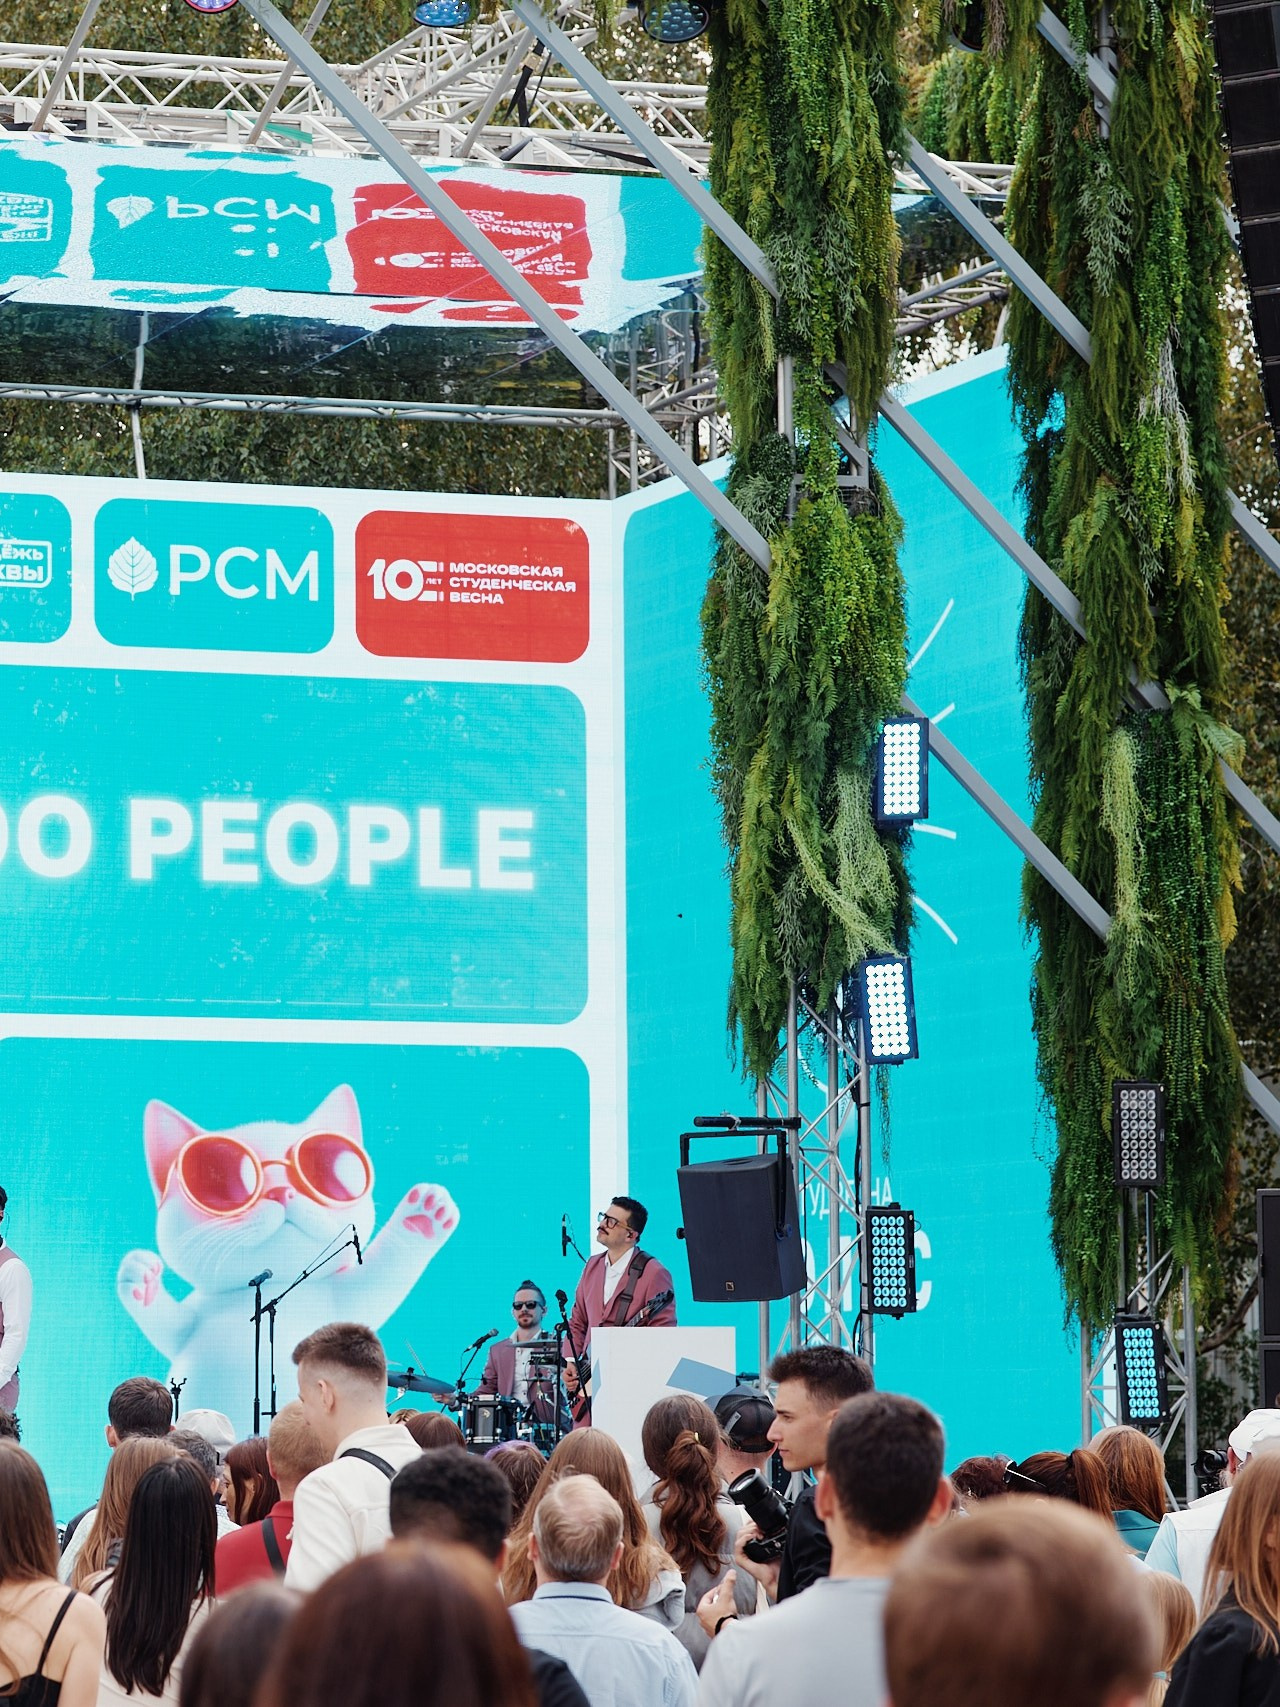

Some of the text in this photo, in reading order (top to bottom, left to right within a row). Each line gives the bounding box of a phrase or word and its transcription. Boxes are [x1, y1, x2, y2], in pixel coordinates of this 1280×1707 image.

[169, 544, 319, 602] РСМ
[449, 562, 564, 577] МОСКОВСКАЯ
[367, 558, 424, 602] 10
[425, 577, 442, 585] ЛЕТ
[449, 577, 576, 592] СТУДЕНЧЕСКАЯ
[449, 591, 504, 604] ВЕСНА
[129, 797, 535, 890] PEOPLE
